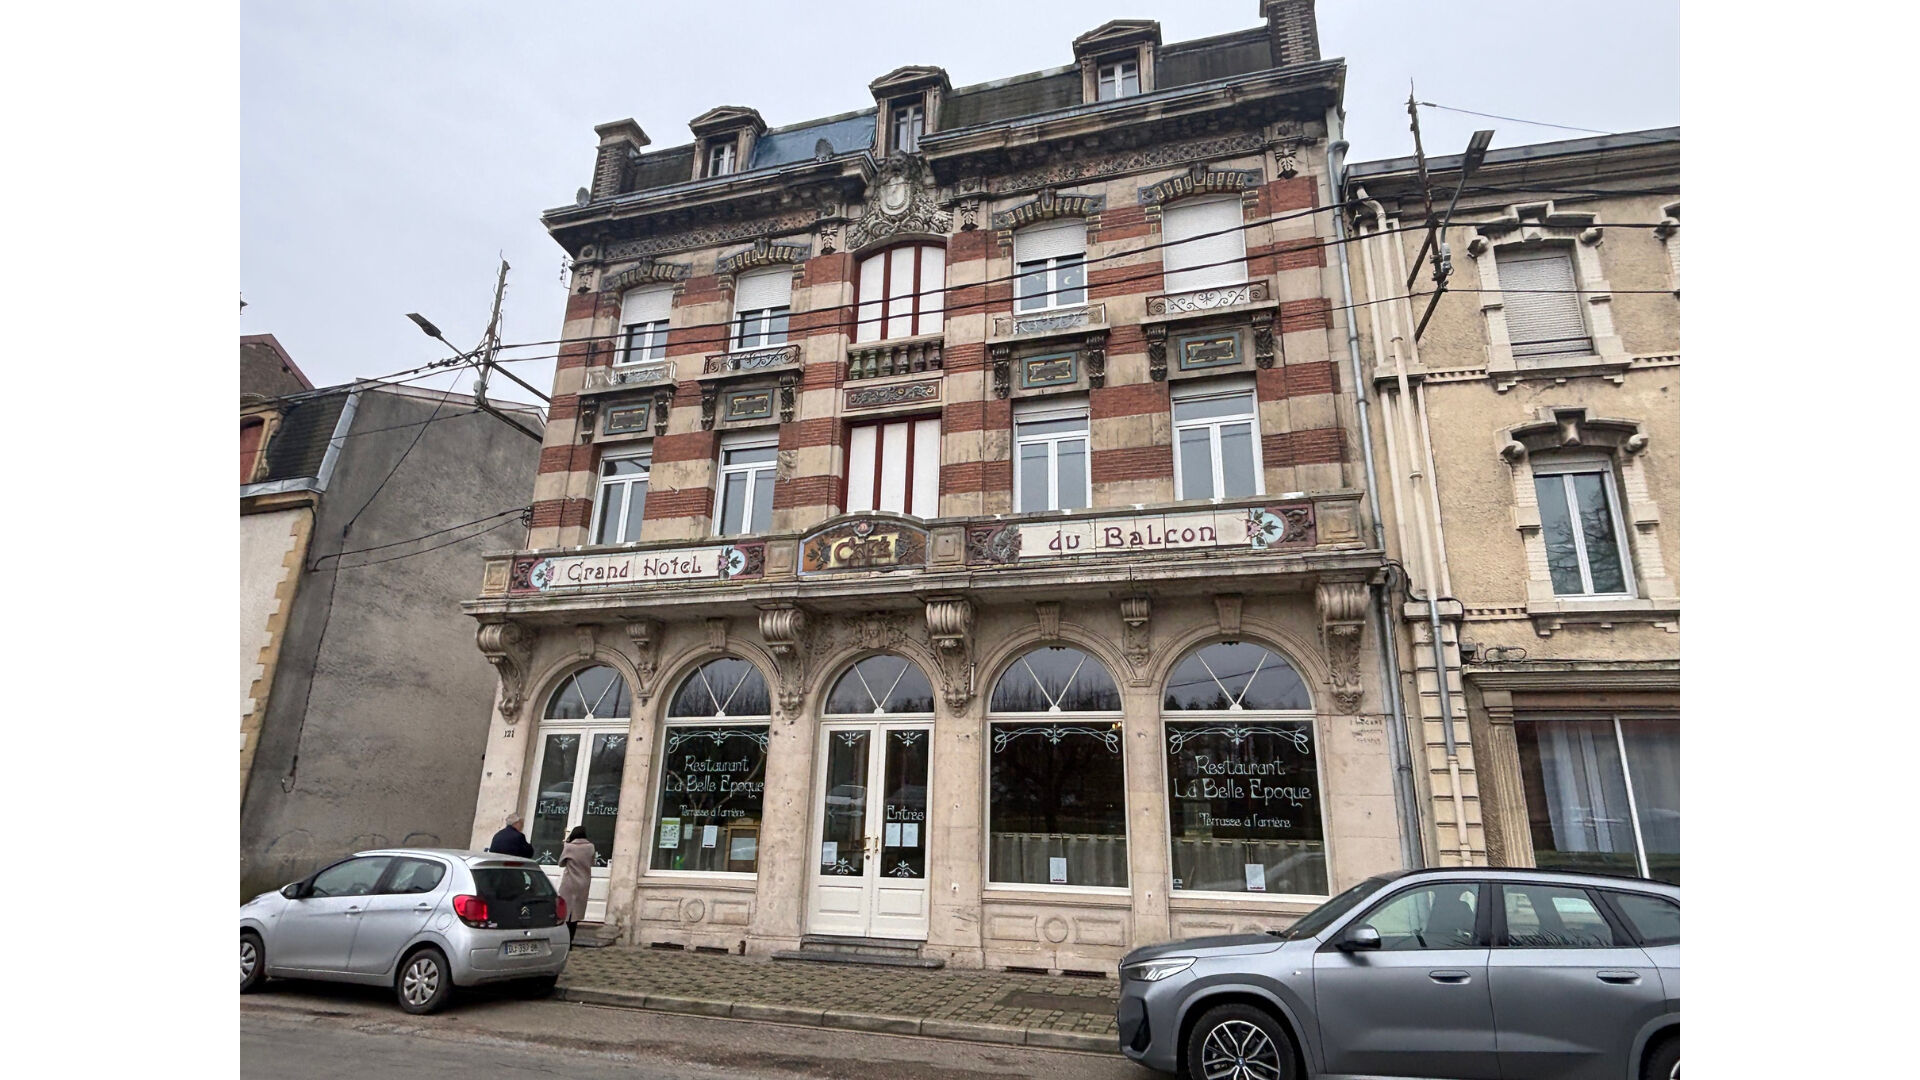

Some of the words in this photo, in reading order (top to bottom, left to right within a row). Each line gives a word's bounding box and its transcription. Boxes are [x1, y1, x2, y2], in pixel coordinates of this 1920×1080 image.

[1048, 529, 1080, 551] du
[567, 559, 631, 583] Grand
[684, 755, 749, 772] Restaurant
[1195, 755, 1286, 775] Restaurant
[666, 774, 682, 792] La
[686, 774, 717, 792] Belle
[720, 774, 765, 799] Epoque
[1174, 778, 1197, 798] La
[1202, 777, 1245, 798] Belle
[1249, 778, 1312, 807] Epoque
[1199, 812, 1242, 827] Terrasse
